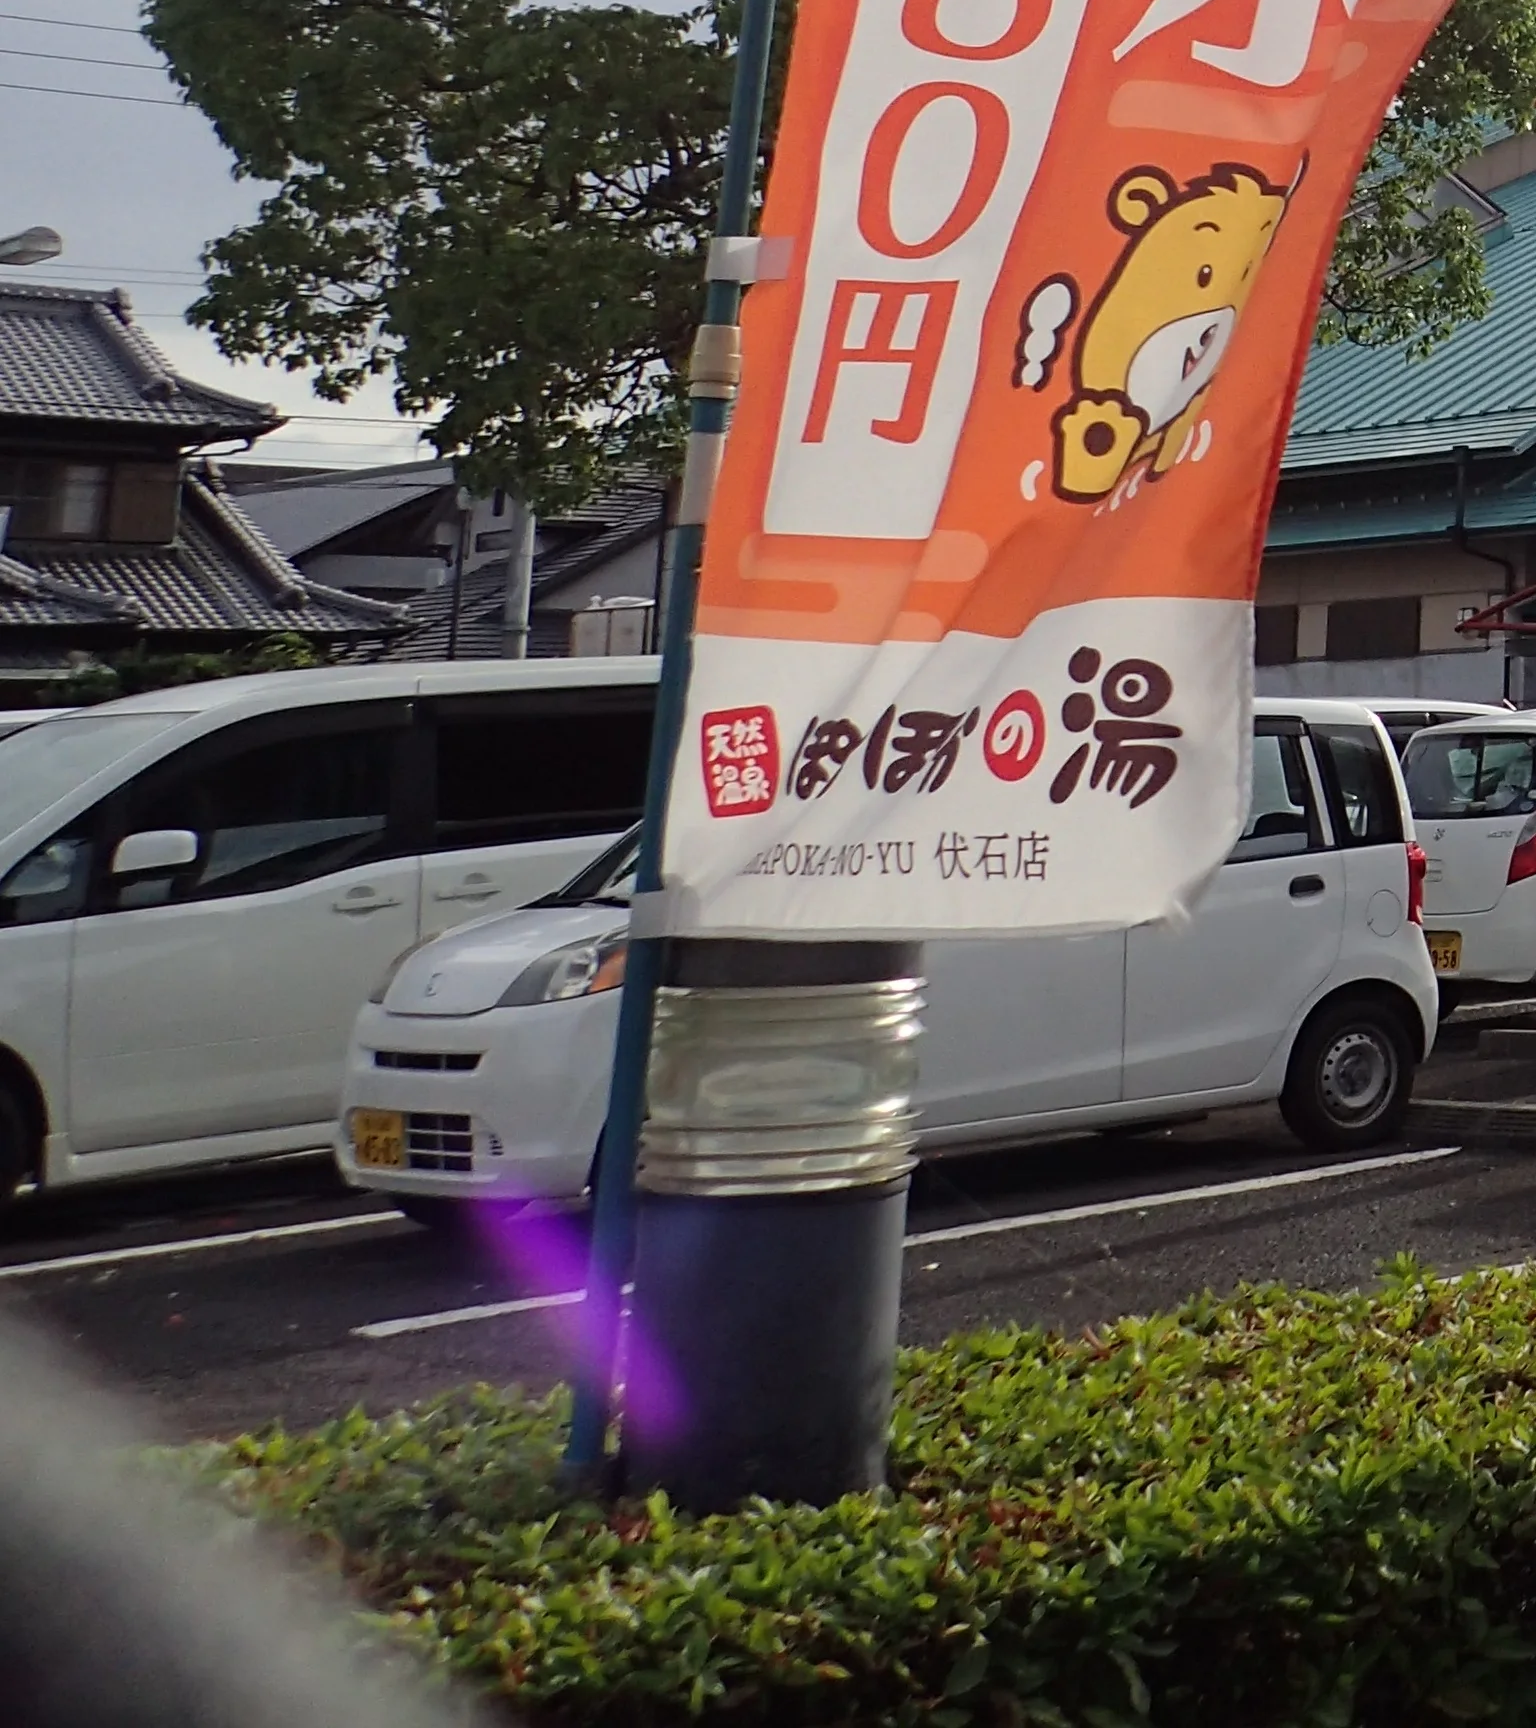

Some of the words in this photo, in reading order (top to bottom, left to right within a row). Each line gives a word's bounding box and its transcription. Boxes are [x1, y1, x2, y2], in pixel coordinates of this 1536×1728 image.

[708, 715, 768, 759] 天然
[712, 758, 770, 806] 温泉
[934, 831, 1051, 883] 伏石店
